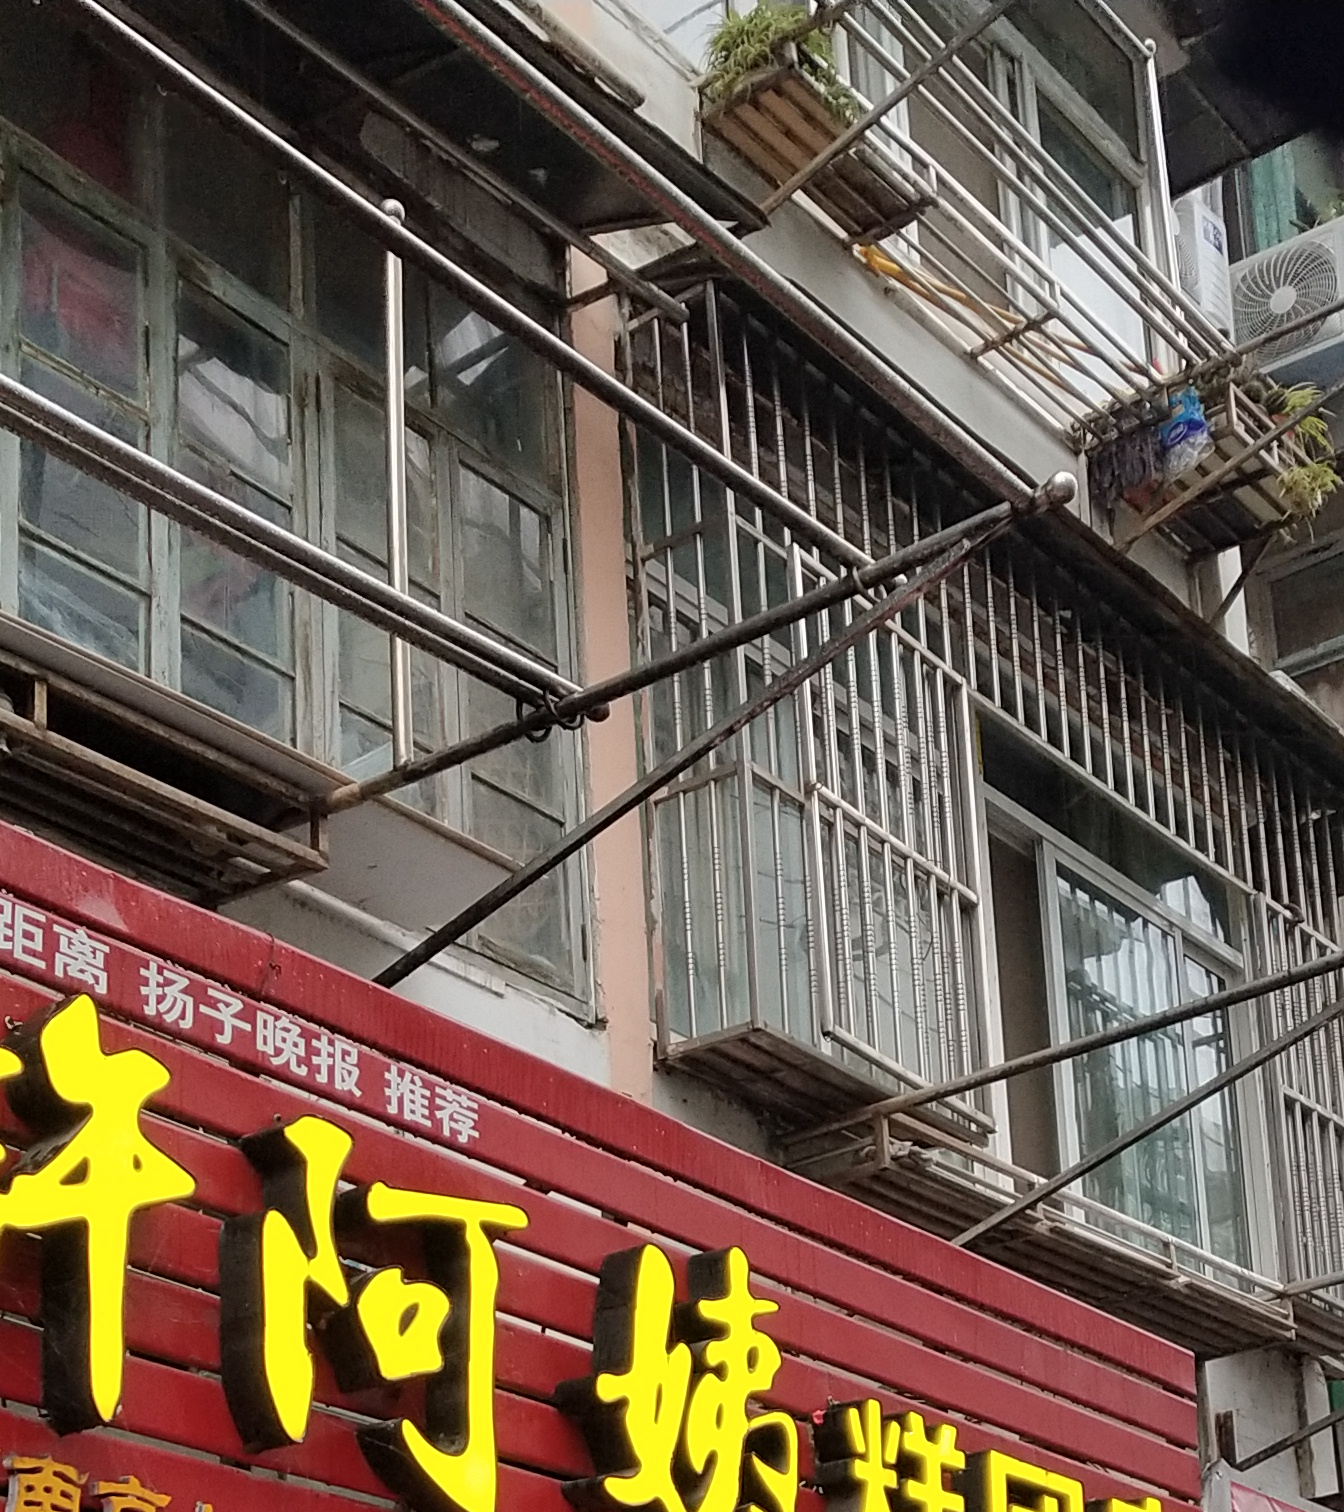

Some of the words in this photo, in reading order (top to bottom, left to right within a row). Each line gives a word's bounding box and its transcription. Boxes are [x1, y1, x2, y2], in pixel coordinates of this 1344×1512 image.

[140, 961, 361, 1098] 扬子晚报
[385, 1064, 480, 1145] 推荐
